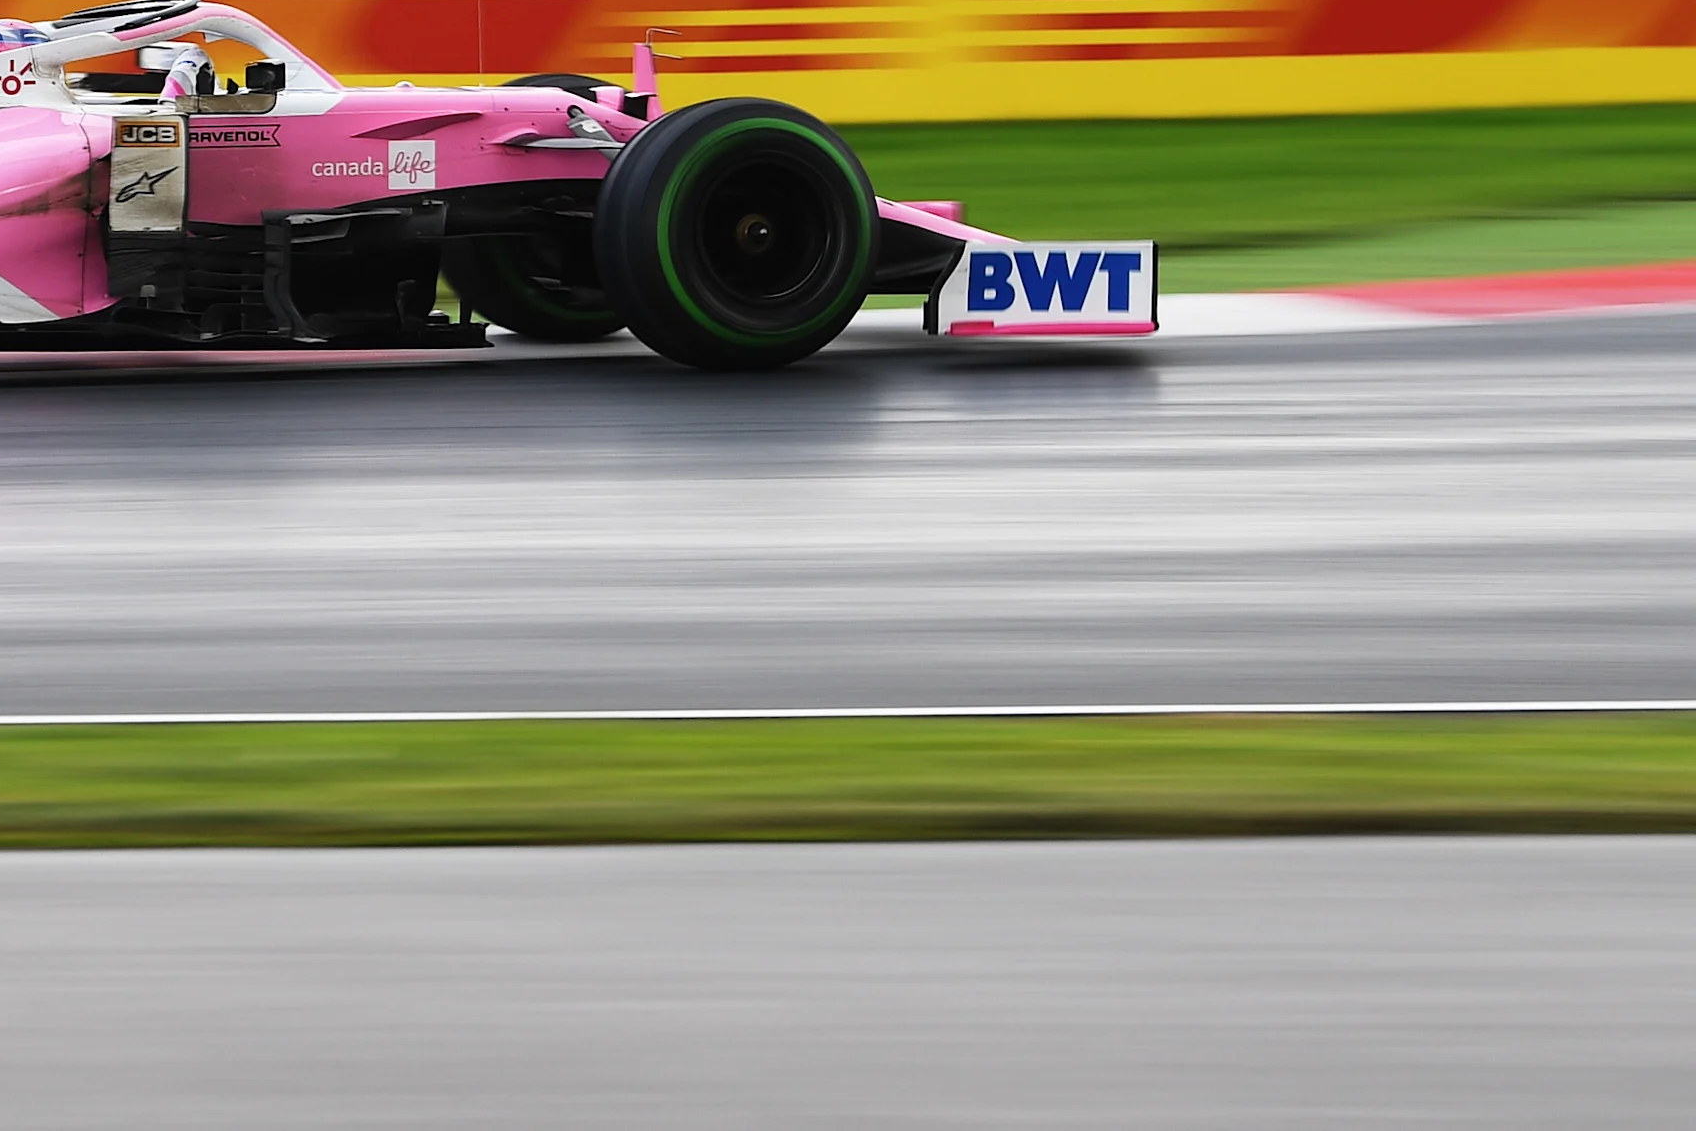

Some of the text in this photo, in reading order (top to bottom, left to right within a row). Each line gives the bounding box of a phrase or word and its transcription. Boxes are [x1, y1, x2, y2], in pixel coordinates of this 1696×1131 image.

[122, 126, 177, 143] JCB
[311, 151, 436, 184] canada life
[966, 252, 1142, 312] BWT
